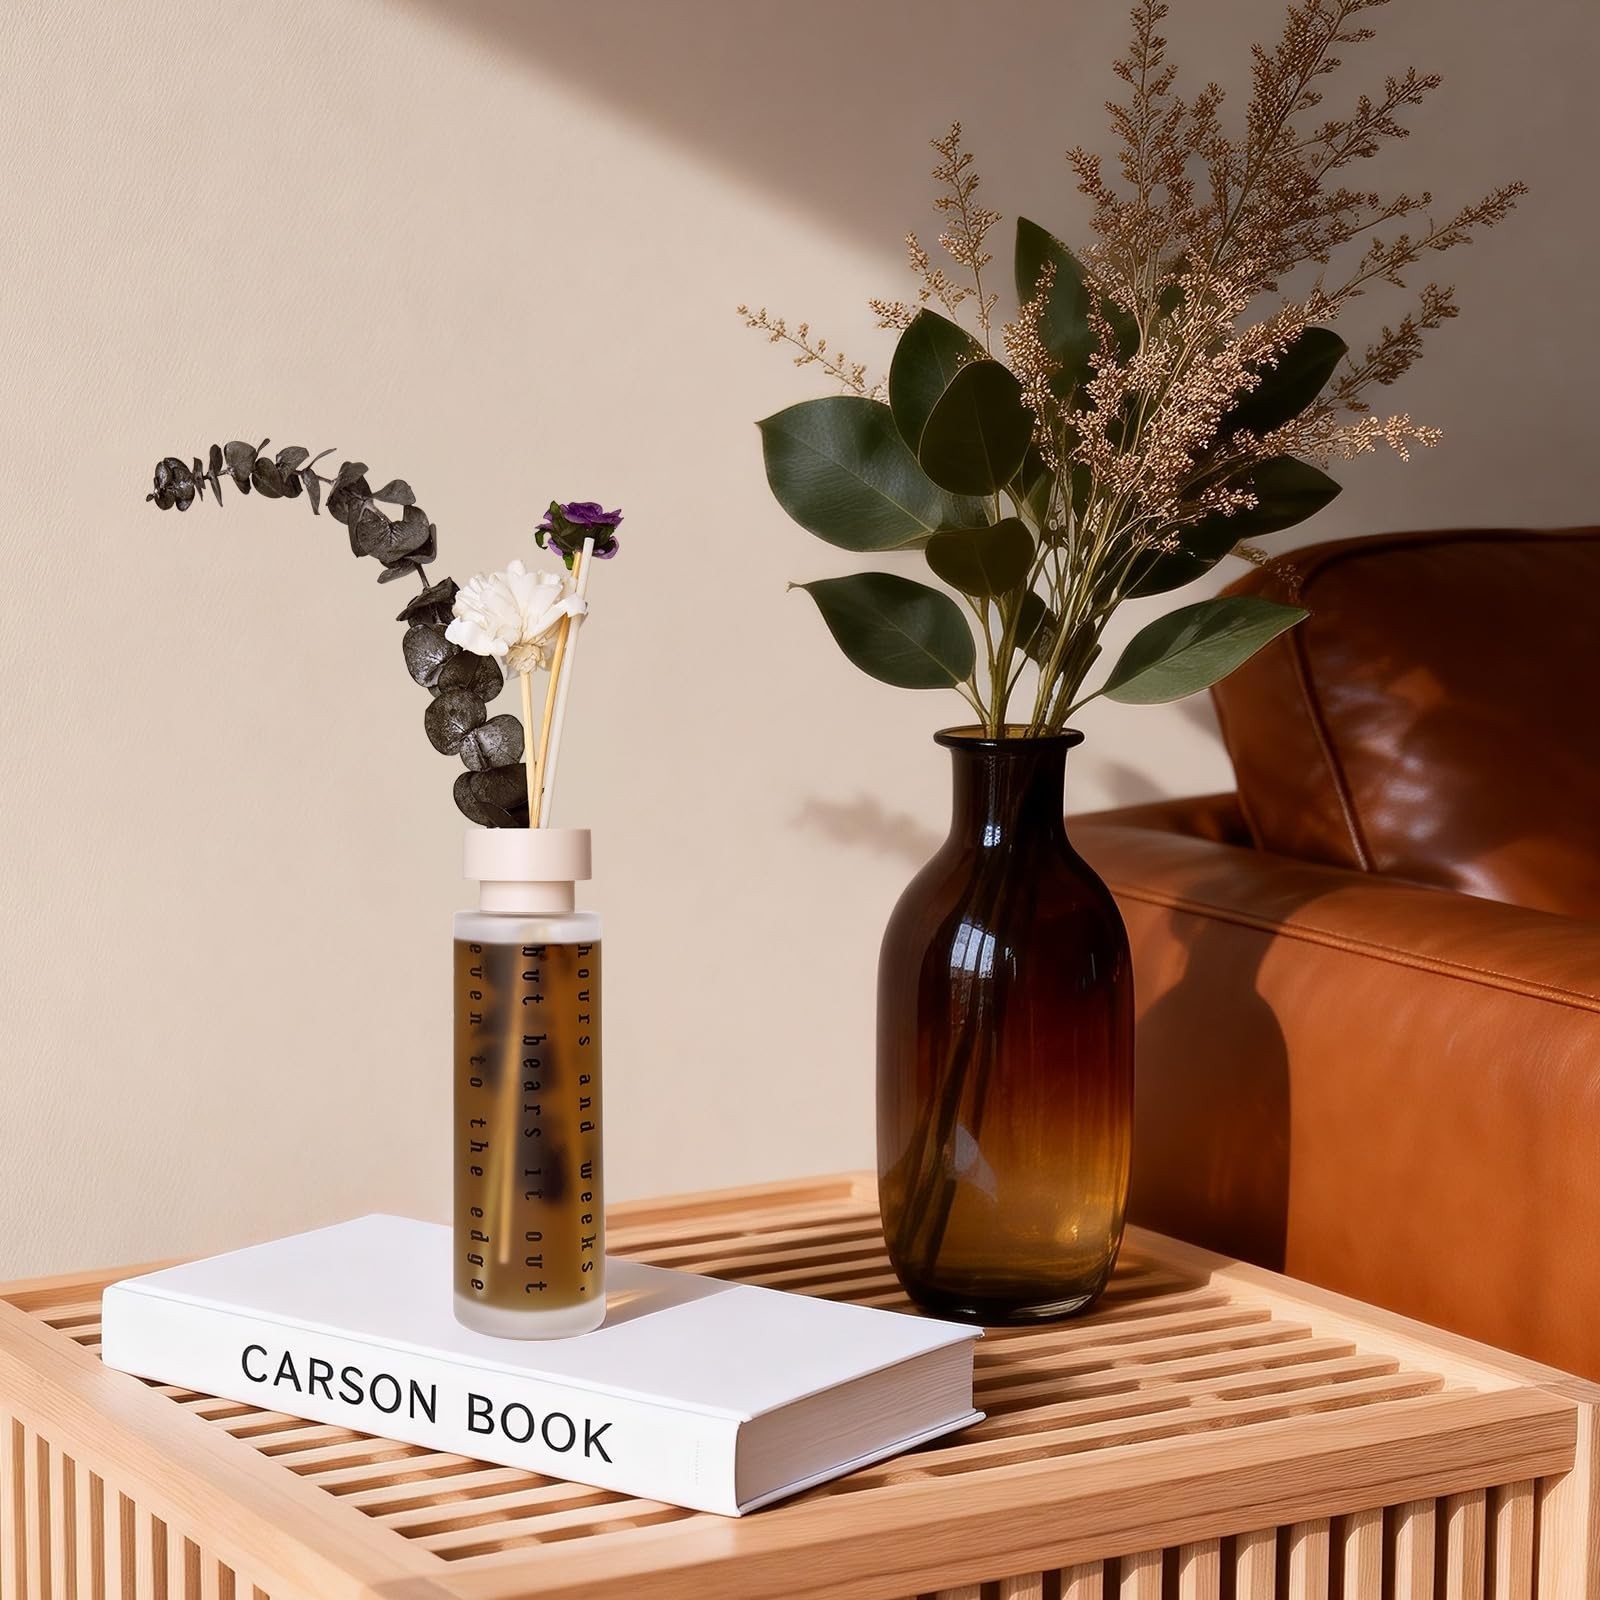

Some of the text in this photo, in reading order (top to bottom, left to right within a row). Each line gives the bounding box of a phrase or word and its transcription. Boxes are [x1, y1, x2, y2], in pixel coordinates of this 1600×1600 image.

[466, 943, 490, 1291] even to the edge
[521, 944, 549, 1294] but bears it out
[577, 943, 597, 1293] hours and weeks.
[241, 1343, 437, 1425] CARSON
[466, 1392, 613, 1465] BOOK
